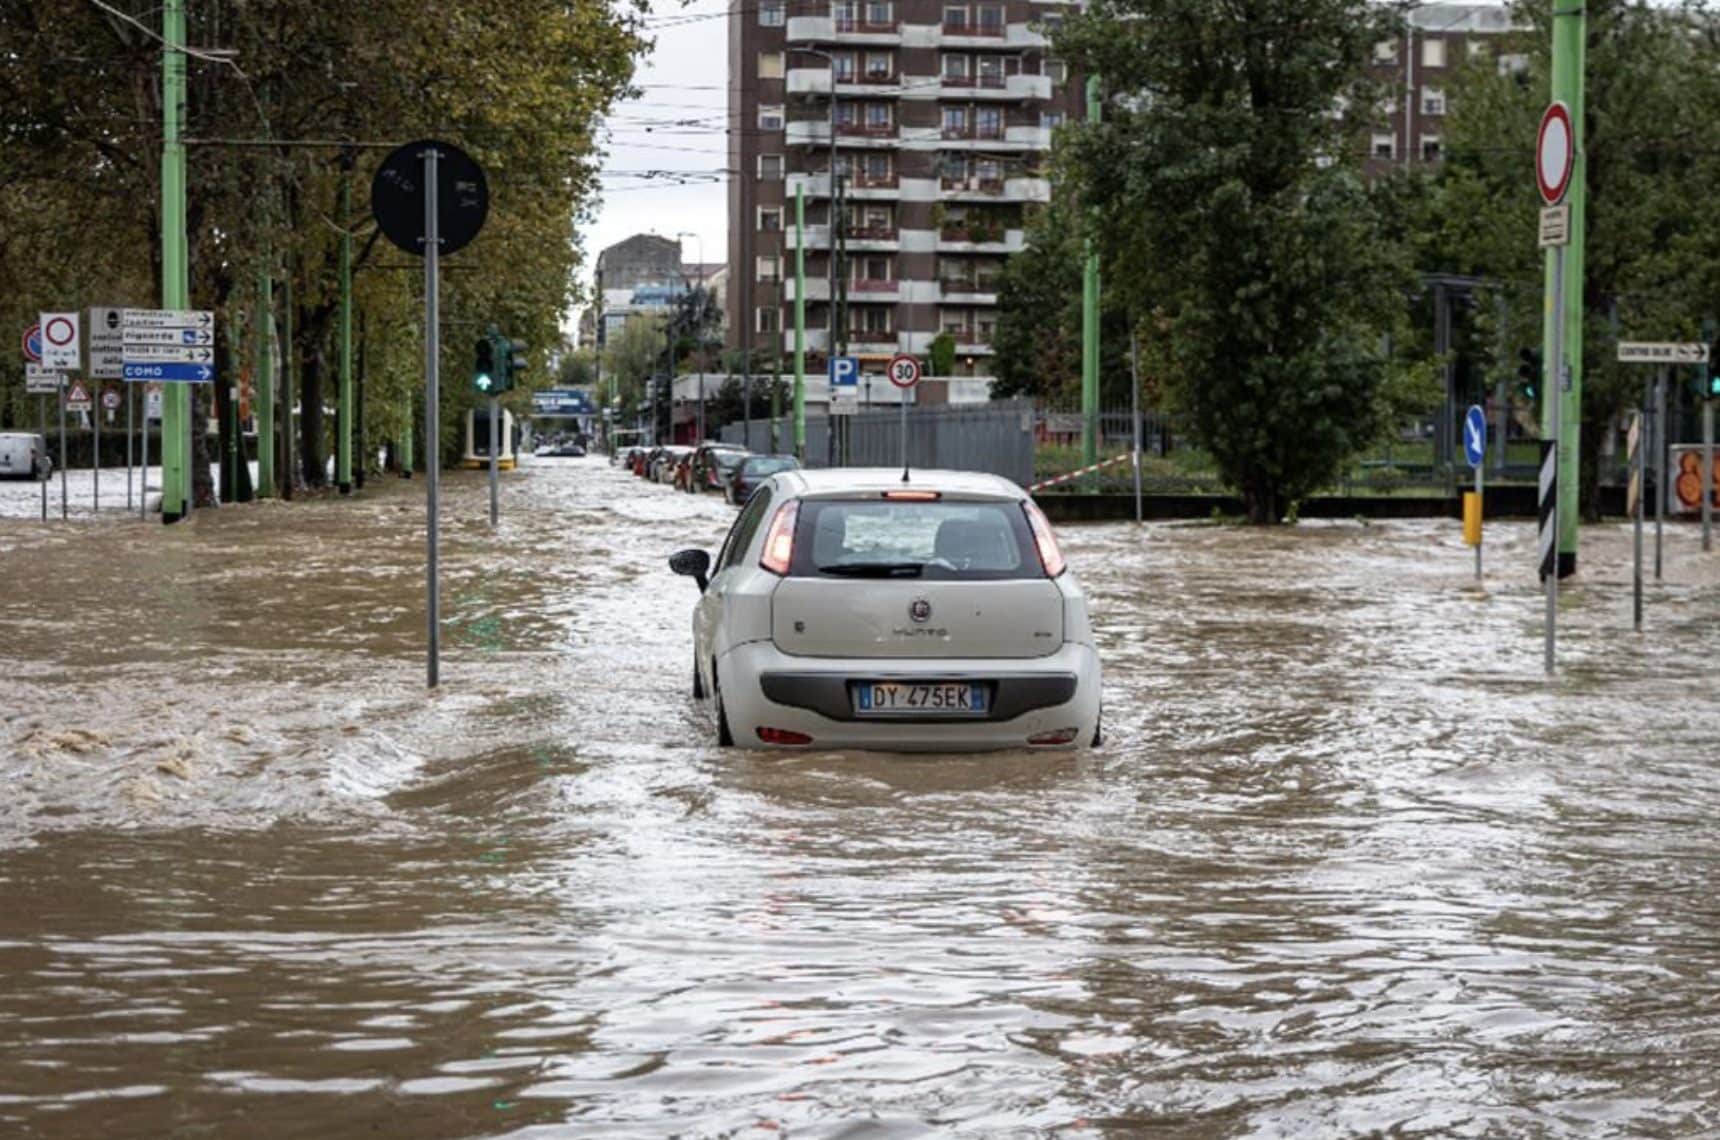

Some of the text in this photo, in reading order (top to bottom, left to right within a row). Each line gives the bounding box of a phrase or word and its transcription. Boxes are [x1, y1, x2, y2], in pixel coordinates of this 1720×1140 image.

[125, 366, 163, 376] COMO
[834, 359, 853, 382] P
[896, 364, 914, 379] 30
[874, 686, 969, 708] DY 475EK
